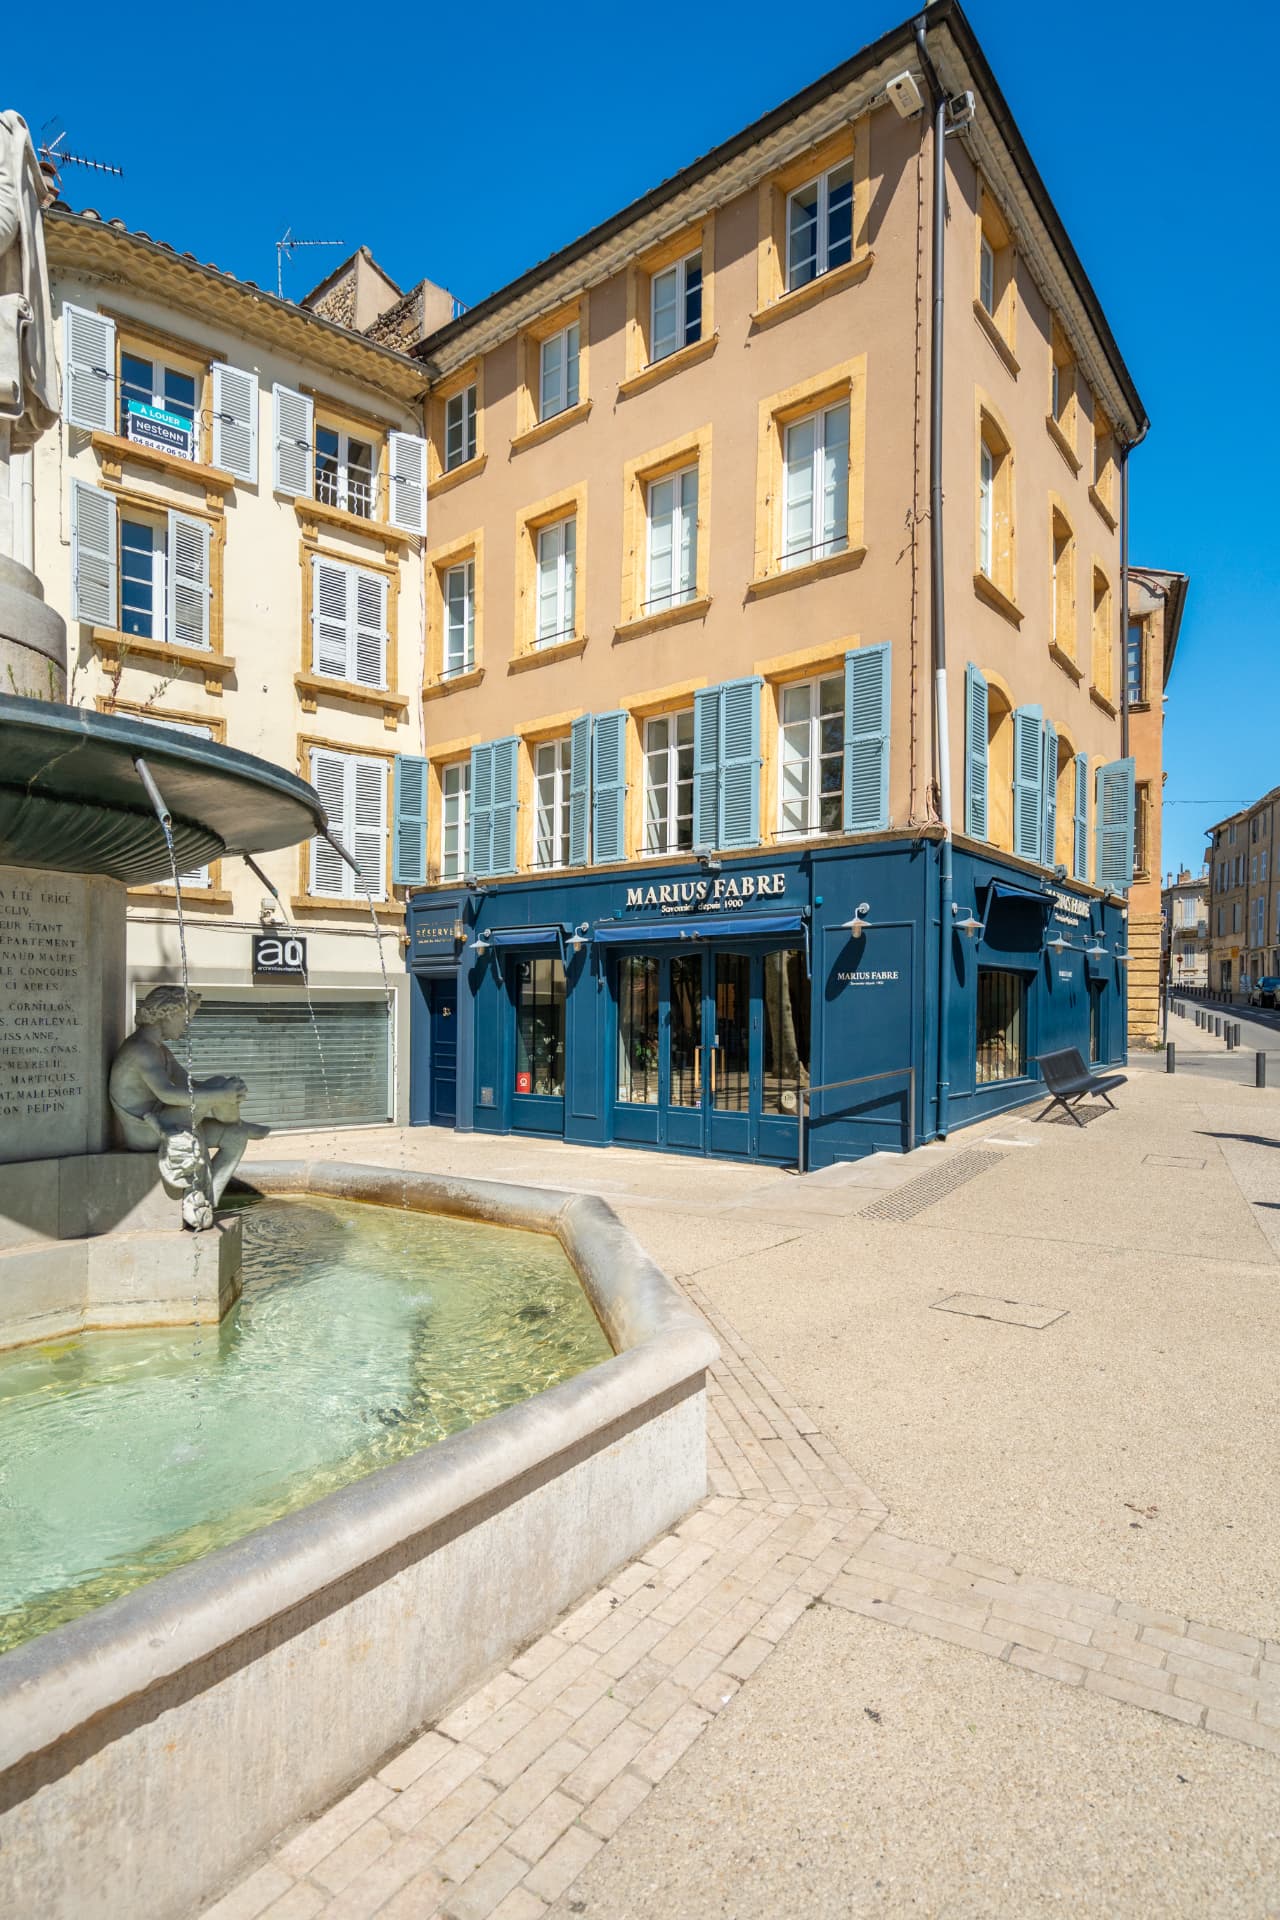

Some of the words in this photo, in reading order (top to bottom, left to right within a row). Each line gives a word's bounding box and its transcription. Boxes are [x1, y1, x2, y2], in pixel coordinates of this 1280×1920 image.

[149, 409, 180, 425] LOUER
[133, 436, 143, 444] 04
[626, 881, 707, 906] MARIUS
[713, 873, 786, 898] FABRE
[724, 899, 744, 909] 1900
[20, 967, 78, 977] CONCOURS
[837, 972, 870, 980] MARIUS
[871, 971, 899, 980] FABRE
